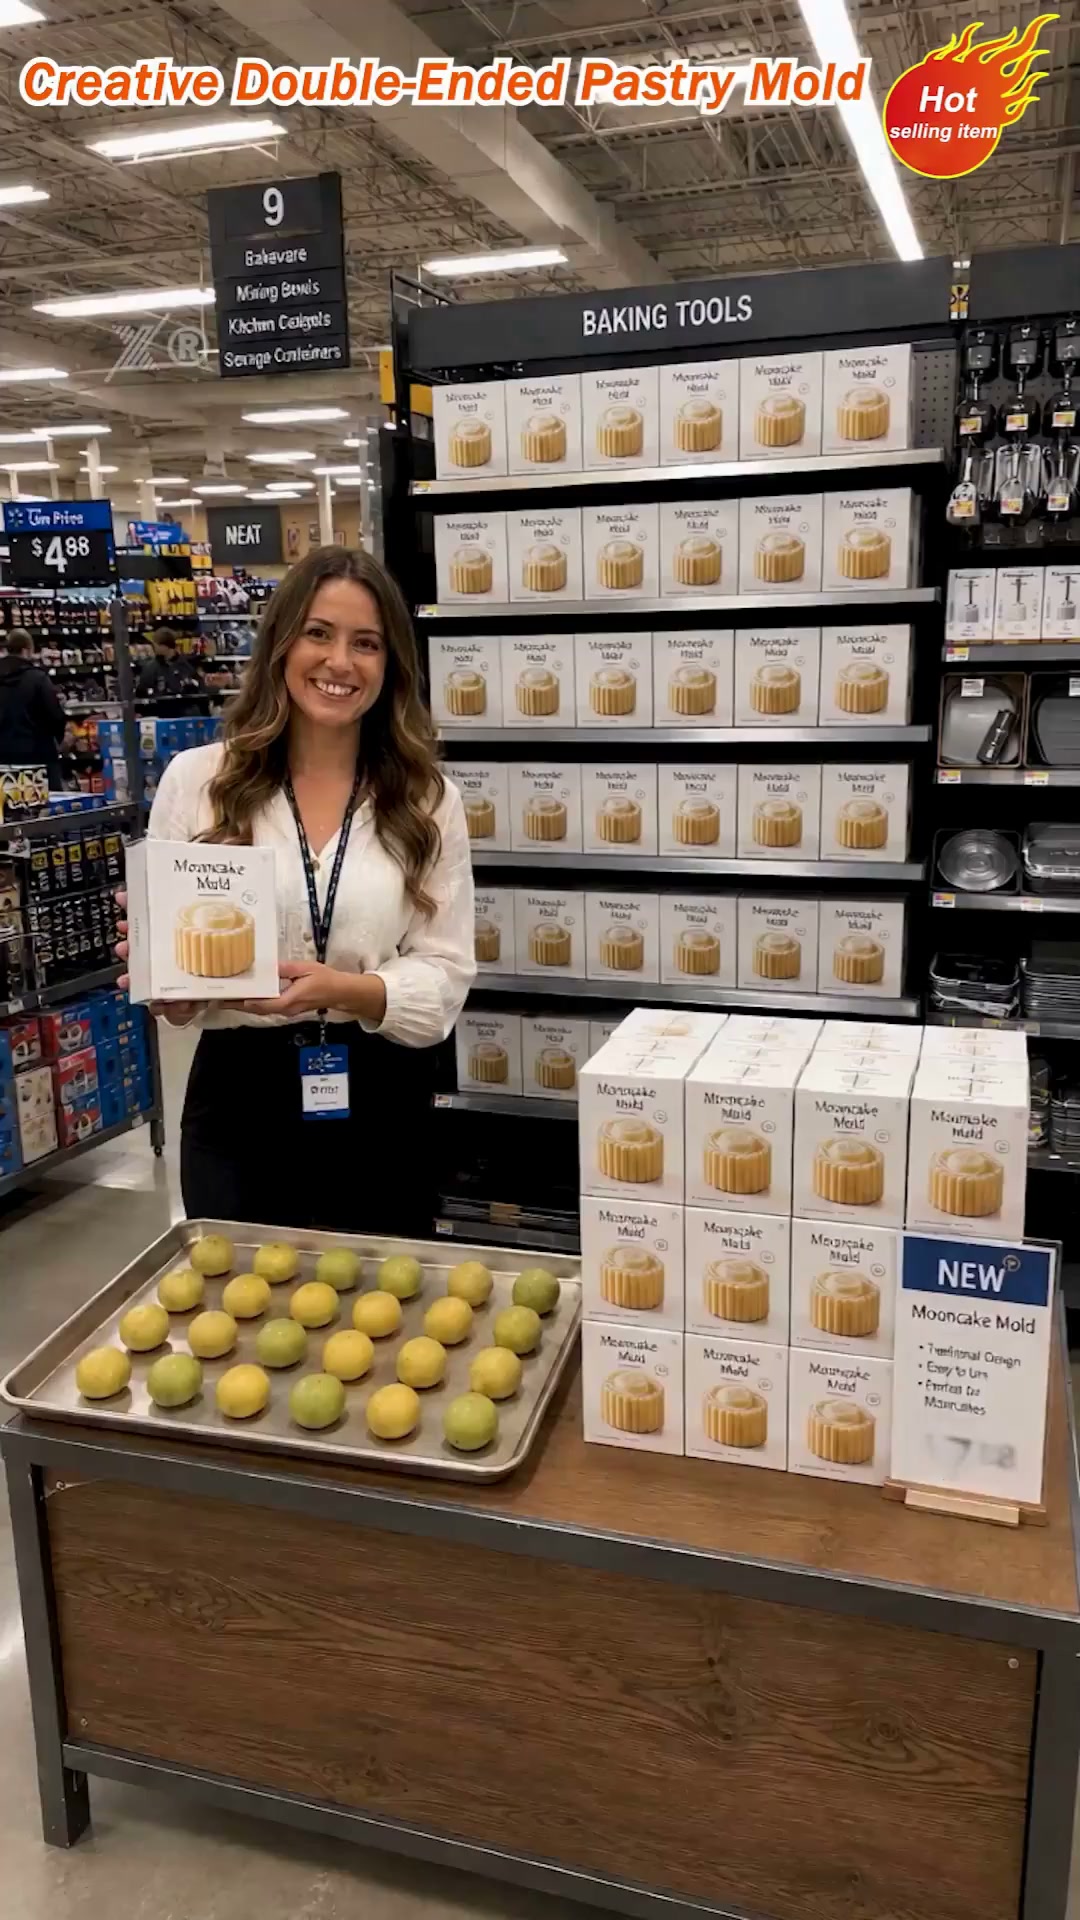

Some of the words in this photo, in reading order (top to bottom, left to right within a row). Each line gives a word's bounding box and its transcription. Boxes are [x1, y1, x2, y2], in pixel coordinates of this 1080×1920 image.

[262, 186, 285, 226] 9
[582, 303, 668, 337] BAKING
[674, 294, 753, 328] TOOLS
[225, 523, 263, 546] NEAT
[937, 1258, 1006, 1293] NEW
[911, 1303, 992, 1329] Mooncake
[995, 1315, 1036, 1335] Mold
